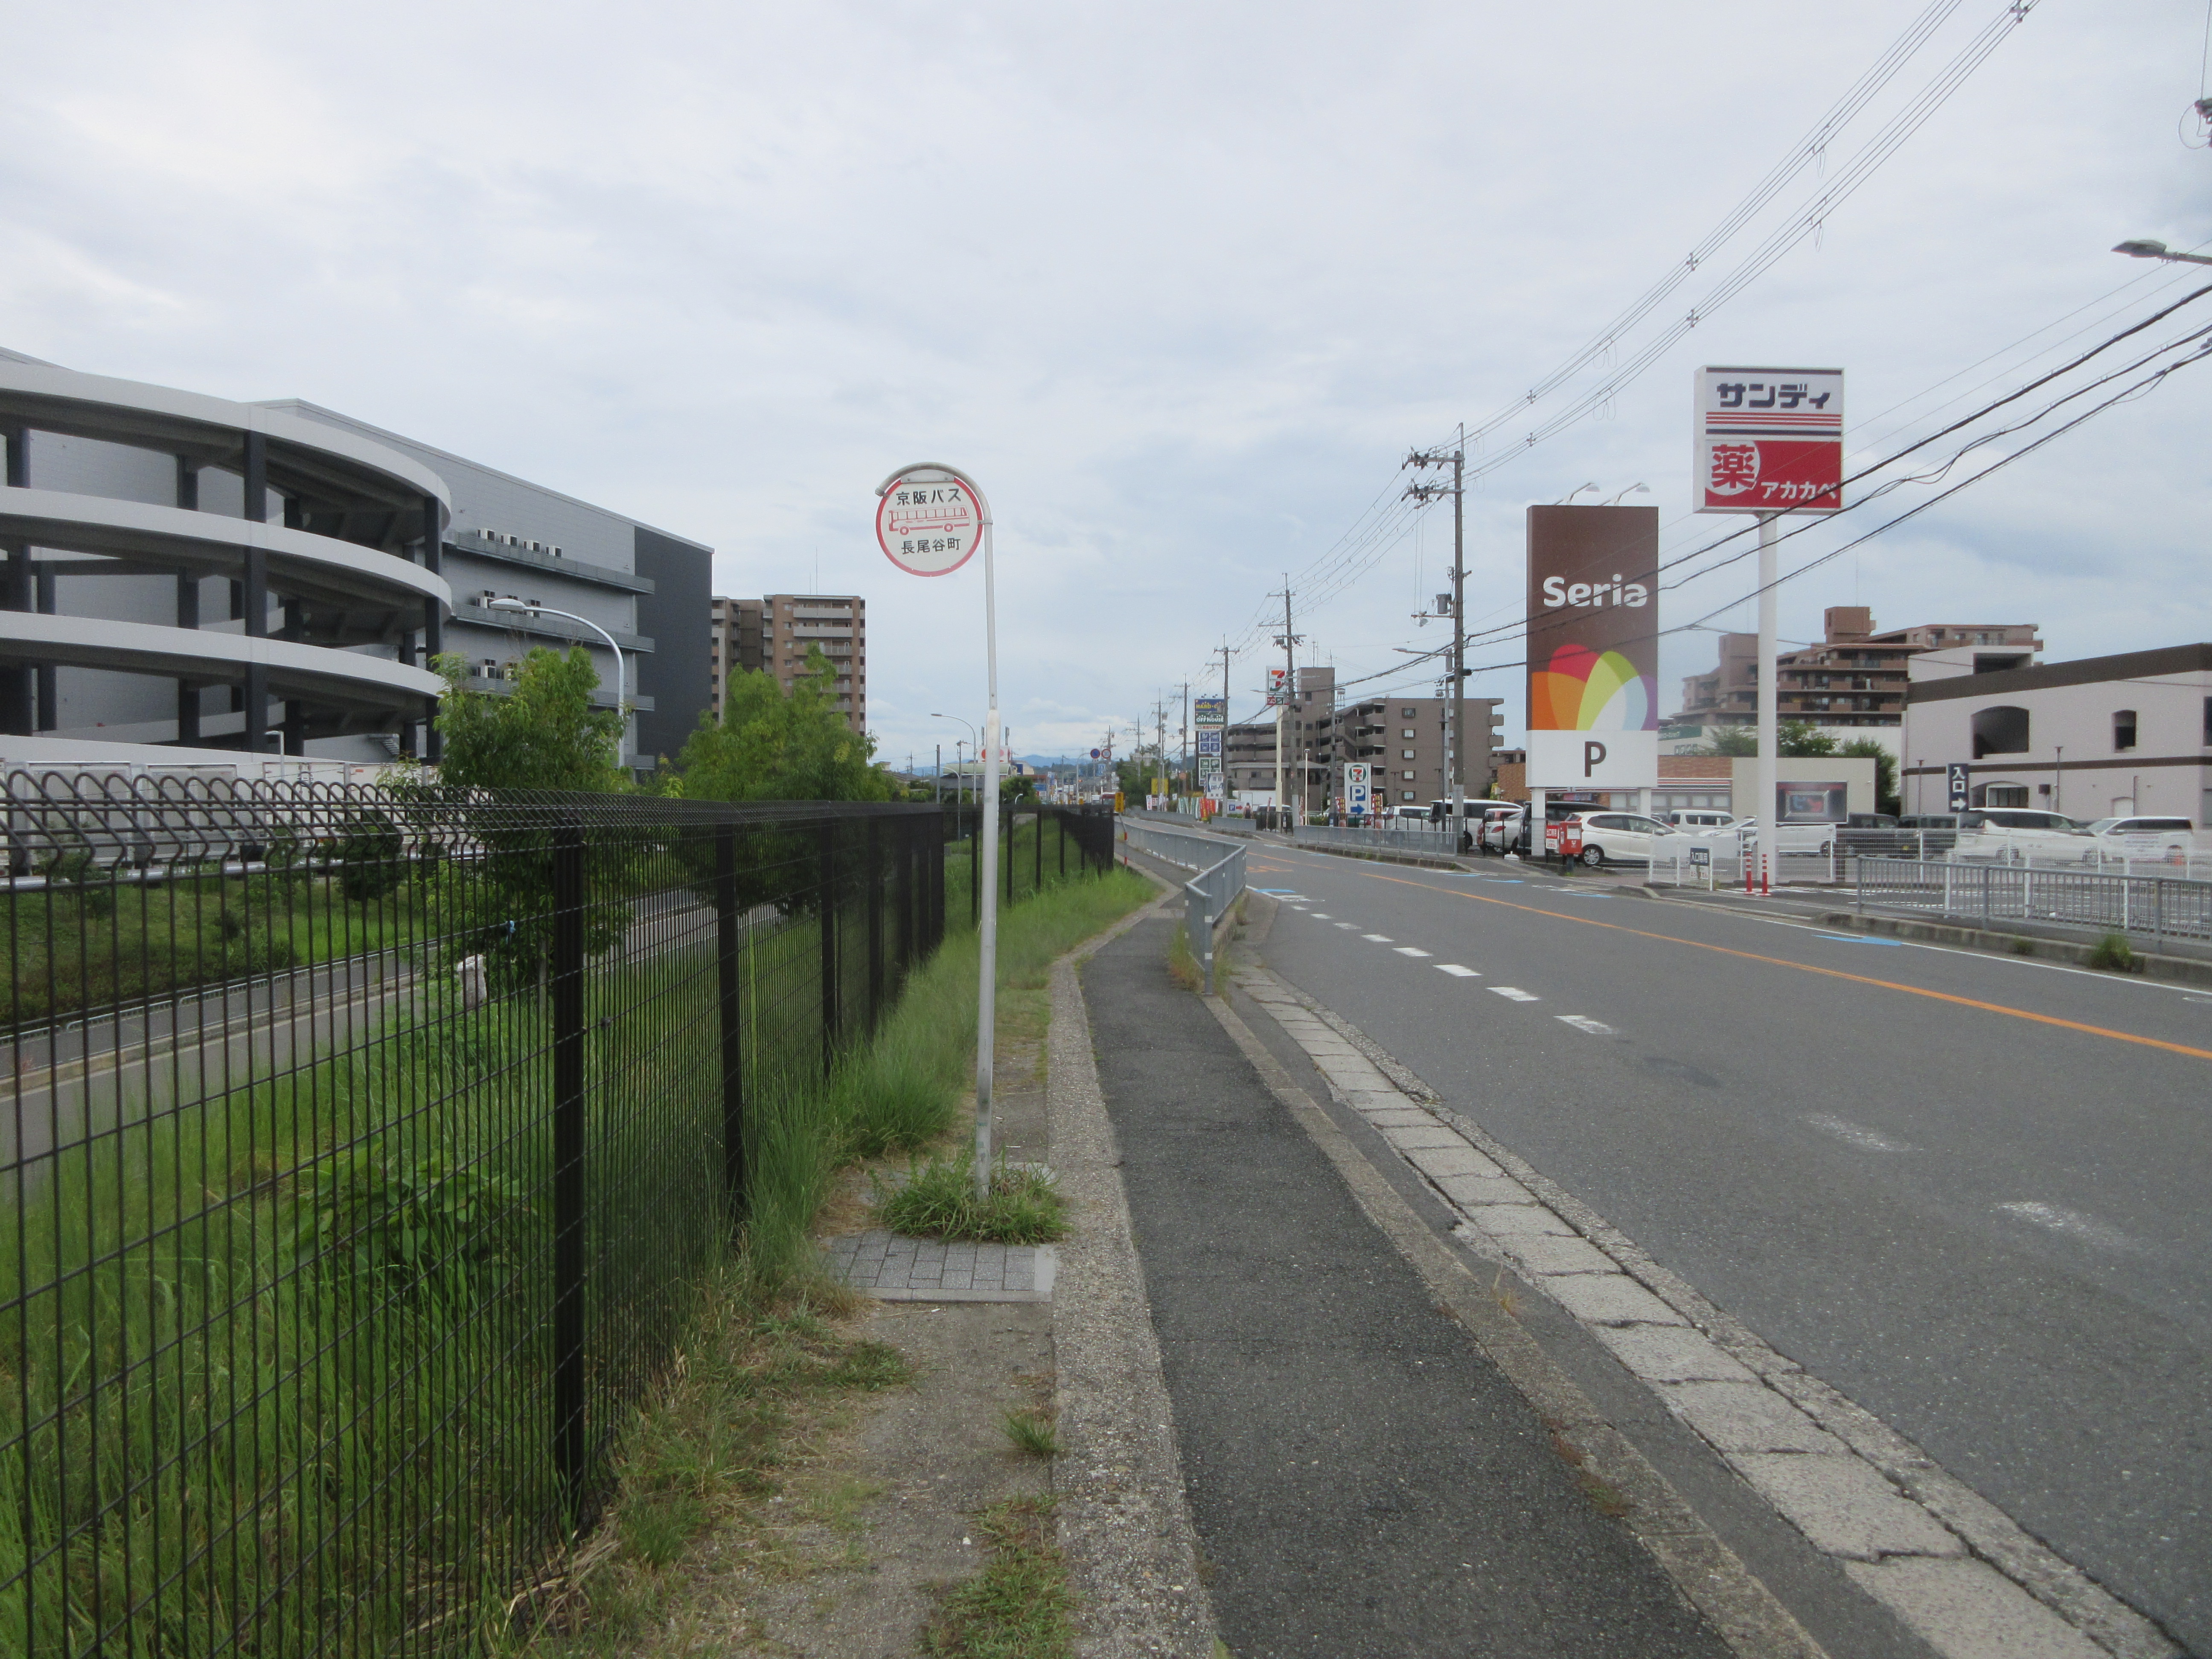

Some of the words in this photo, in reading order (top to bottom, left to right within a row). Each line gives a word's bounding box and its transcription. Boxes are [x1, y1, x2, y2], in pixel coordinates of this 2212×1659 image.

[1717, 383, 1831, 409] サンディ
[1711, 444, 1755, 489] 薬
[896, 488, 961, 506] 京阪バス
[1761, 481, 1836, 499] アカカベ
[901, 538, 961, 555] 長尾谷町
[1543, 574, 1647, 608] Seria
[1584, 741, 1607, 777] P
[1952, 767, 1965, 792] 入口
[1352, 786, 1365, 800] P
